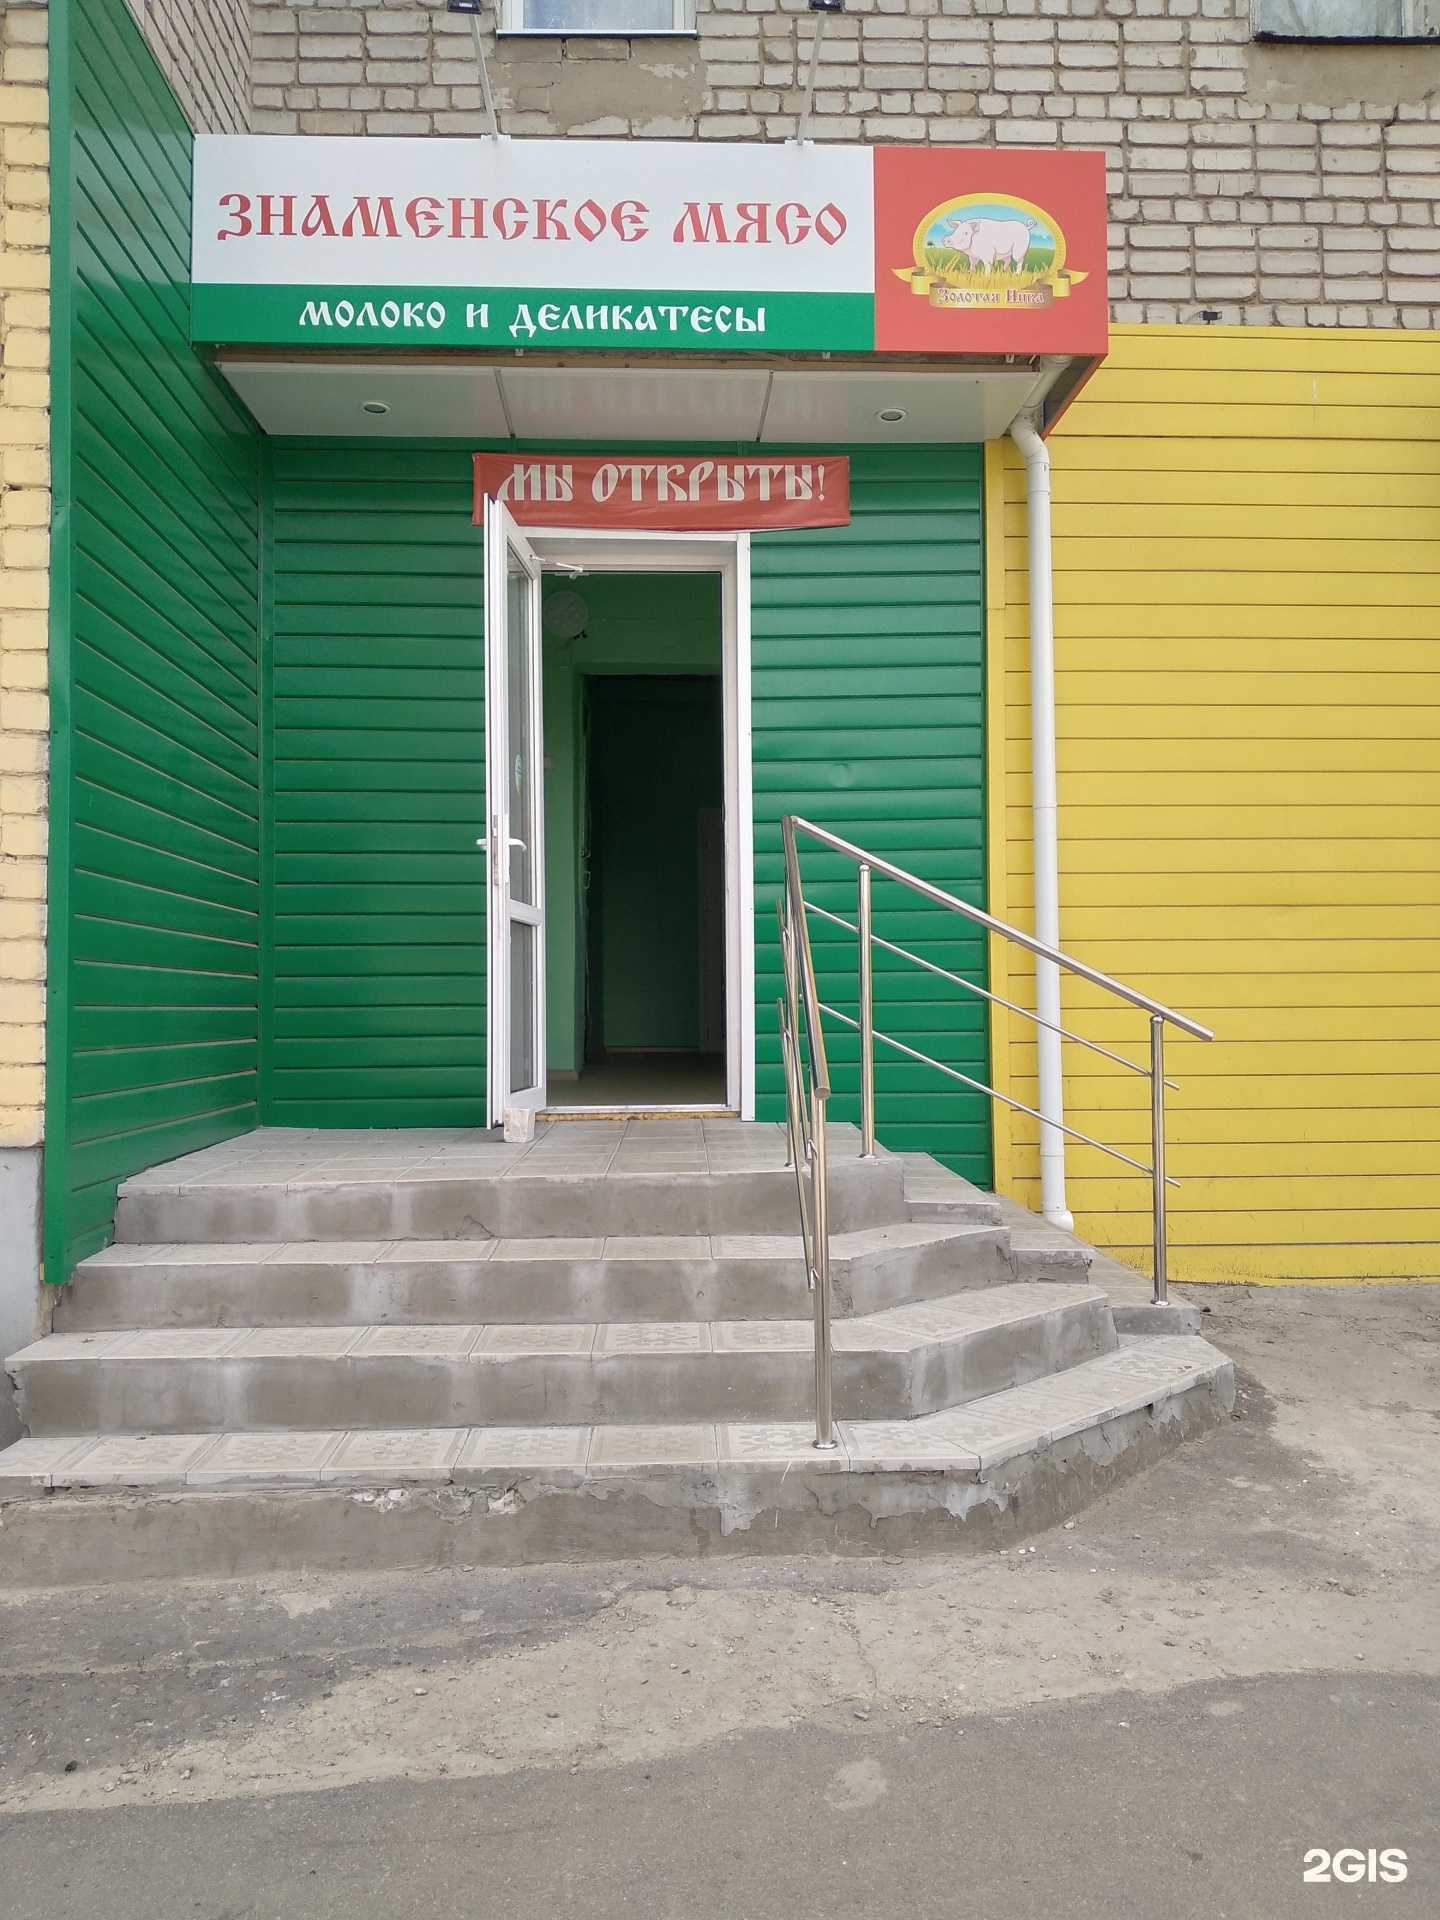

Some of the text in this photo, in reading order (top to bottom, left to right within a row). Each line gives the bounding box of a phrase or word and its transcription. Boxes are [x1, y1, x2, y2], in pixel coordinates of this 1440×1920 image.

[217, 193, 848, 246] ЗНАМЕНСКОЕ МЯСО
[299, 300, 767, 338] МОЛОКО И ДЕЛИКАТЕСЫ
[497, 461, 826, 502] МЫ ОТКРЫТЫ!
